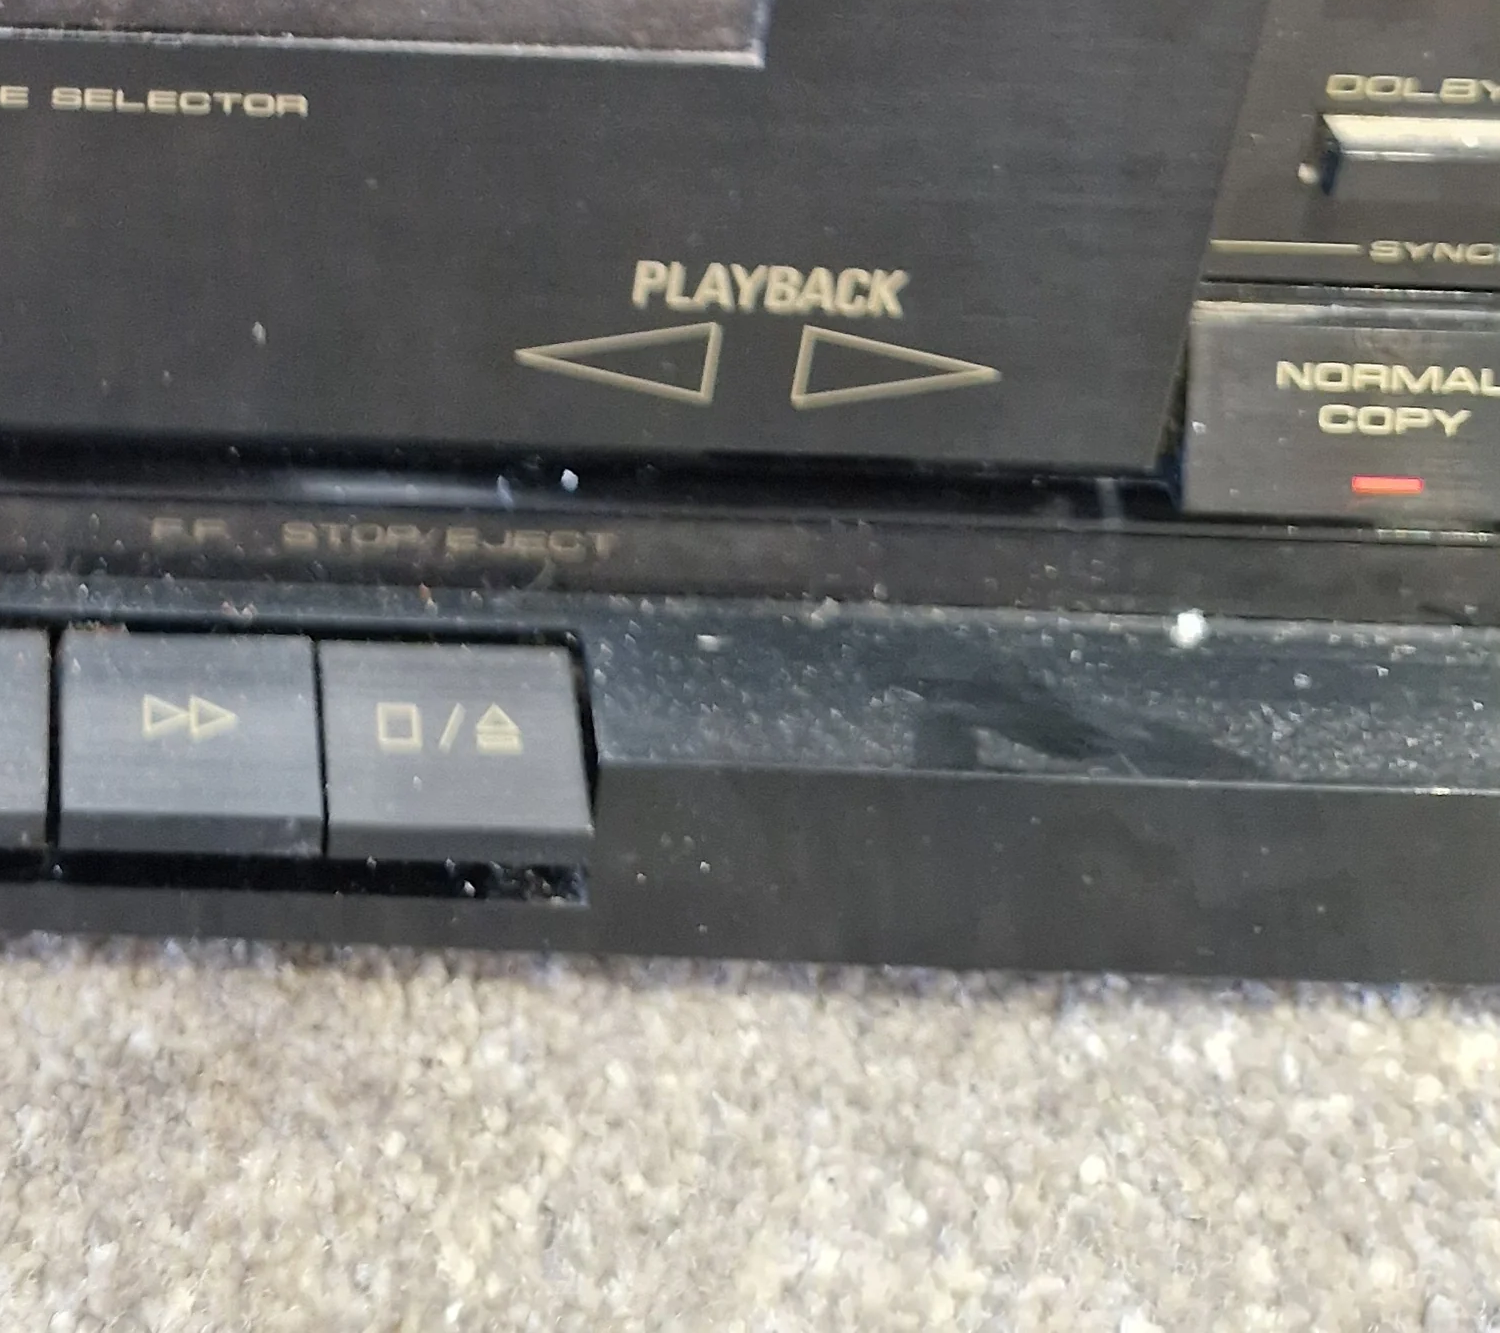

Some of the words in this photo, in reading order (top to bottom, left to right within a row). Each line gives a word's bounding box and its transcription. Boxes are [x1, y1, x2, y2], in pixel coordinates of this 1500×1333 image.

[51, 86, 308, 117] SELECTOR
[1369, 240, 1500, 265] SYNC
[631, 260, 908, 317] PLAYBACK
[1275, 360, 1500, 397] NORMAL
[1318, 404, 1471, 437] COPY
